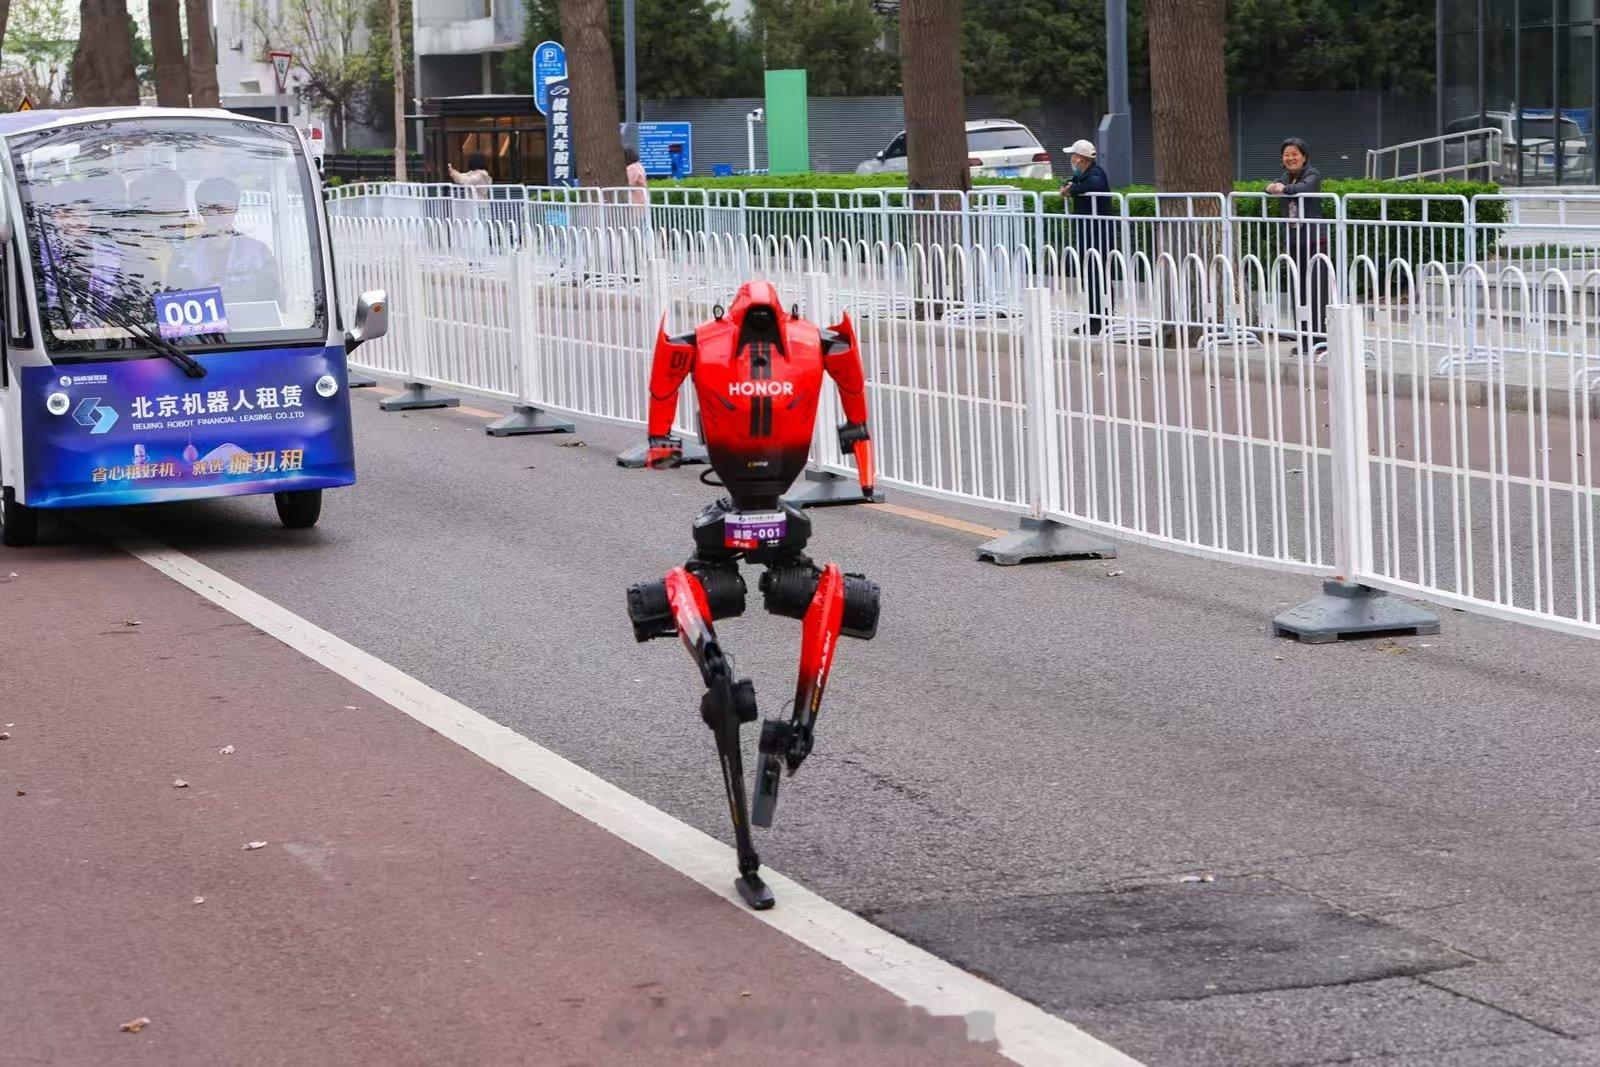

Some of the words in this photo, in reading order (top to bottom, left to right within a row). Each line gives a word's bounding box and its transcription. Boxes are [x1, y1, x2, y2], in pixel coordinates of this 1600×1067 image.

[164, 297, 219, 326] 001
[728, 381, 794, 396] HONOR
[131, 385, 303, 419] 北京机器人租赁
[132, 421, 164, 431] BEIJING
[166, 419, 194, 429] ROBOT
[197, 415, 236, 426] FINANCIAL
[239, 413, 272, 422] LEASING
